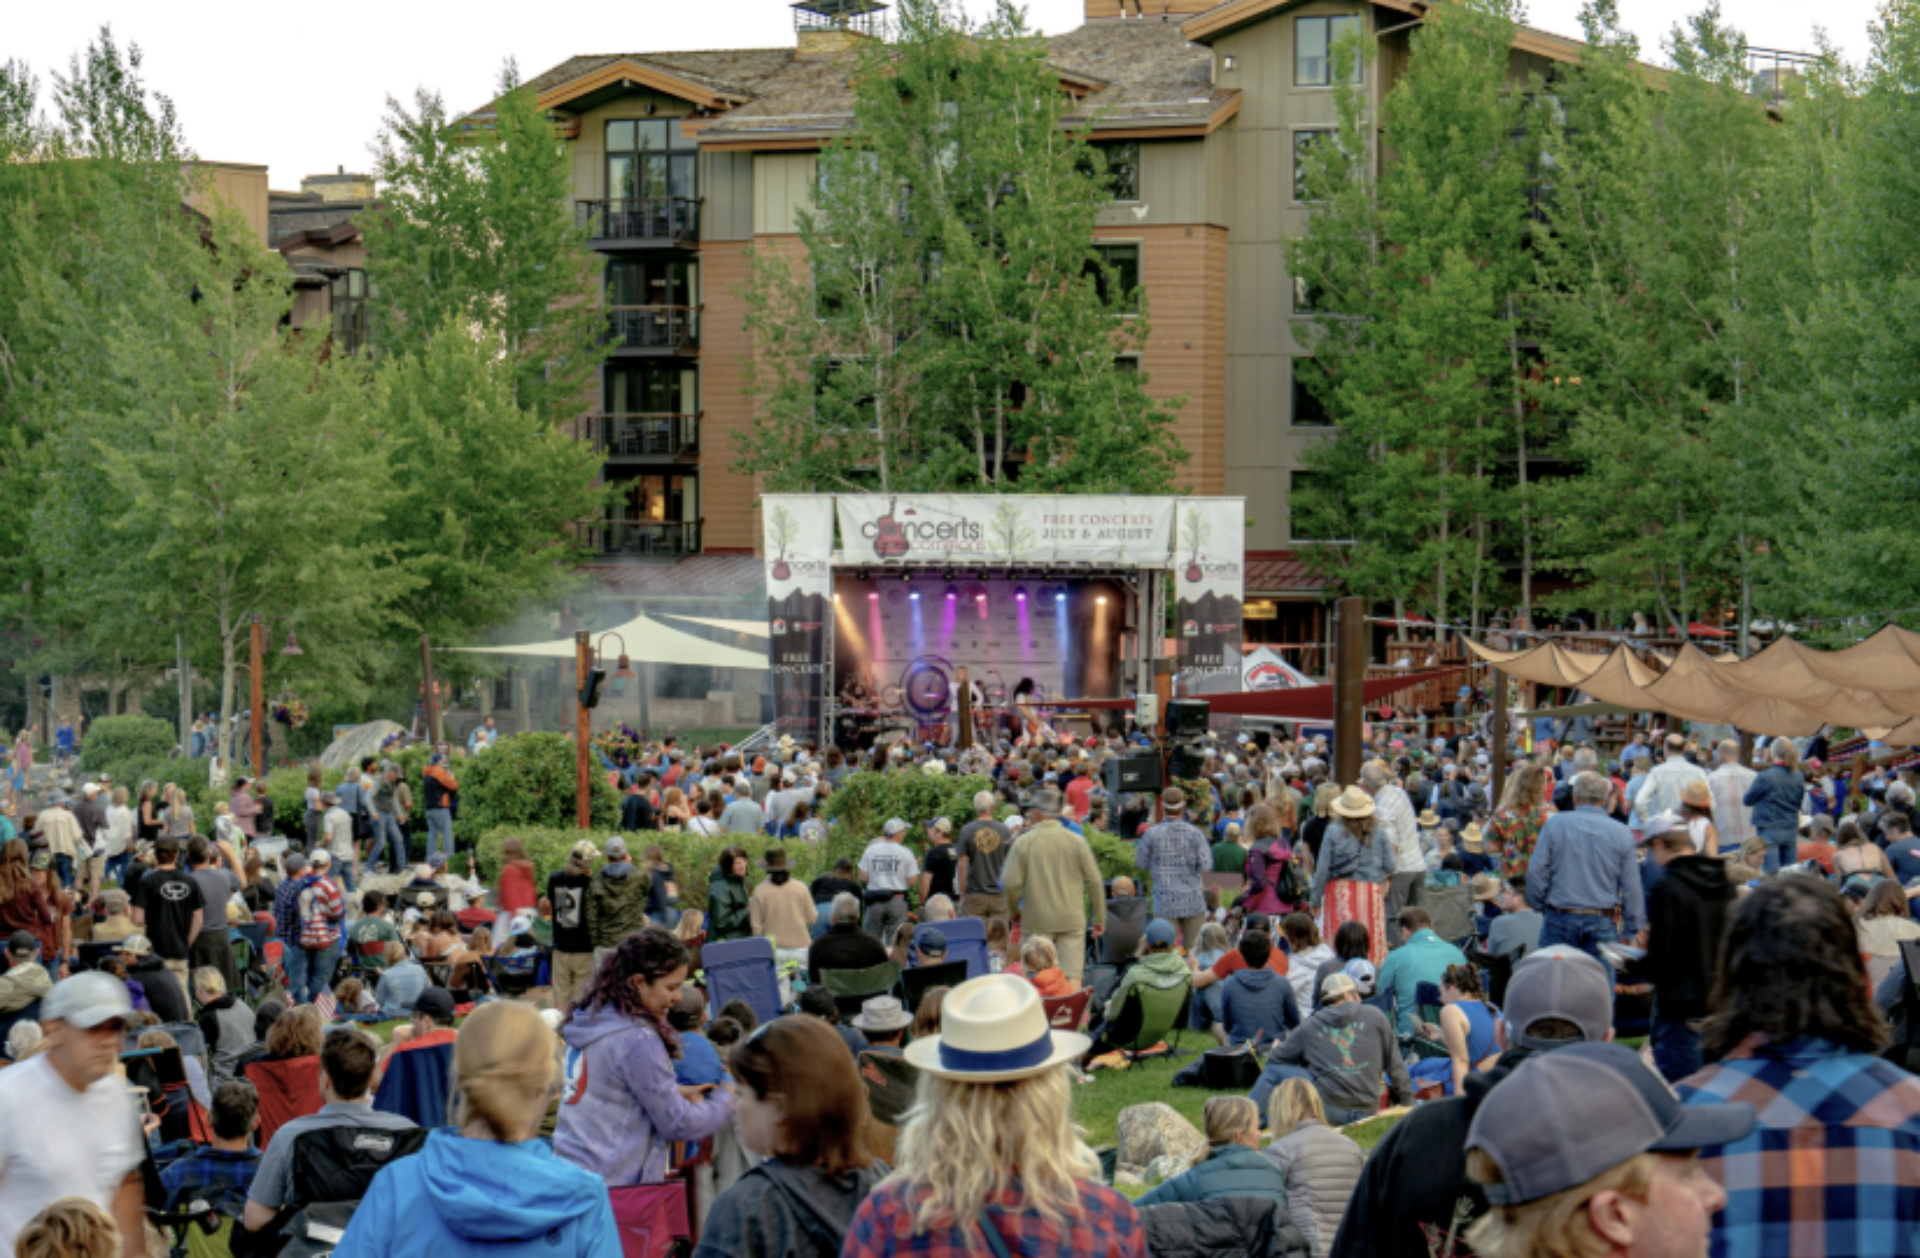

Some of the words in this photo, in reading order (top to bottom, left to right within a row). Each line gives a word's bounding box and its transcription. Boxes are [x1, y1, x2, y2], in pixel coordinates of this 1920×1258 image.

[1043, 514, 1075, 525] FREE
[1080, 514, 1154, 526] CONCERTS
[861, 516, 980, 540] cncerts
[1042, 528, 1076, 540] JULY
[1082, 528, 1091, 539] &
[1097, 528, 1153, 540] AUGUST
[768, 559, 826, 571] cncerts
[1179, 561, 1239, 573] cncerts
[1195, 654, 1222, 664] FREE
